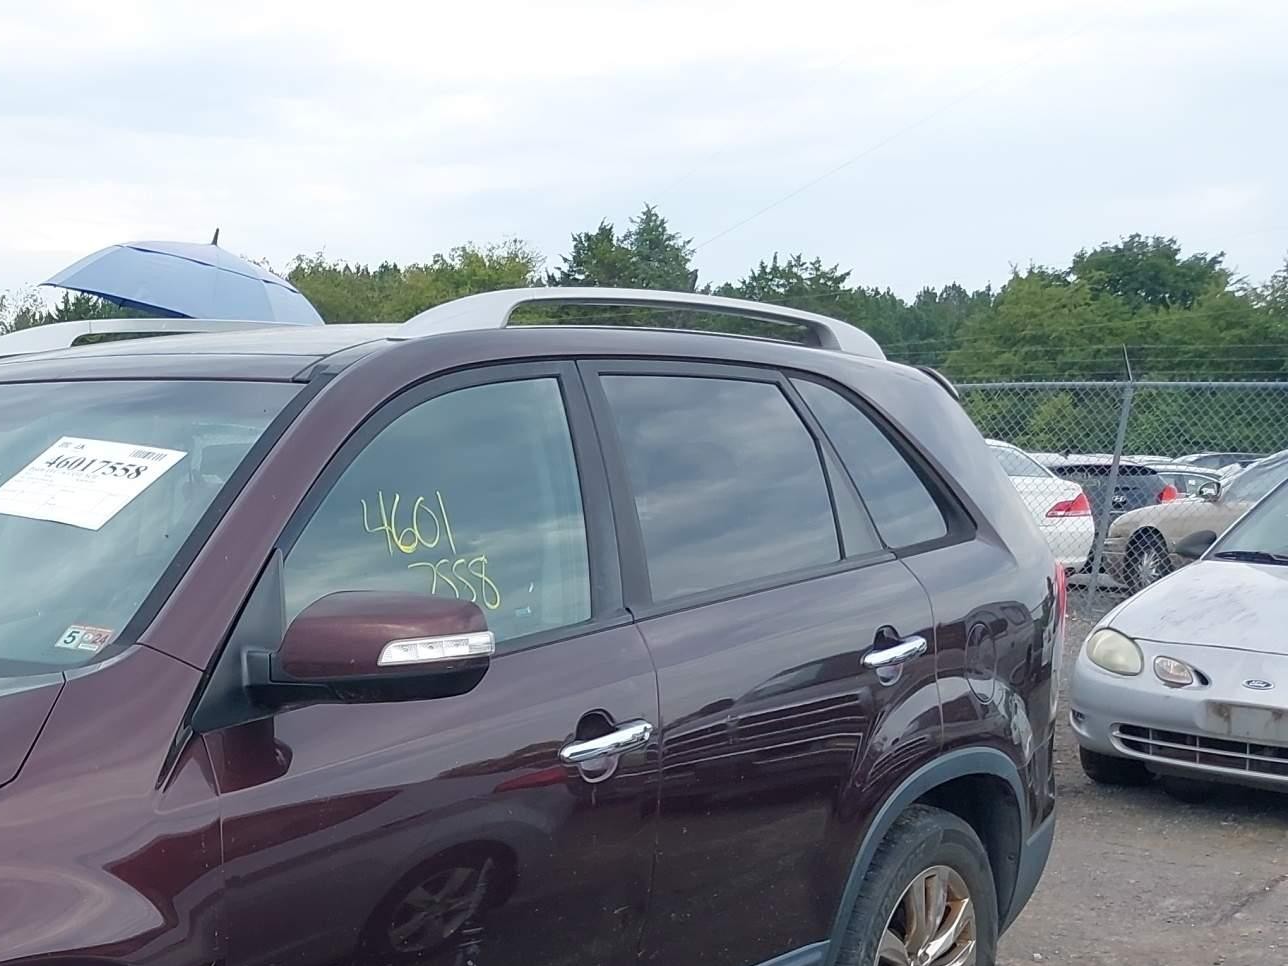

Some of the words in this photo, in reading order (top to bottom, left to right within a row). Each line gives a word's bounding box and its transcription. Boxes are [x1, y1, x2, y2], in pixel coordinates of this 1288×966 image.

[45, 455, 148, 480] 46017558
[360, 490, 457, 557] 4601
[407, 555, 501, 610] 7558
[63, 631, 81, 645] 5
